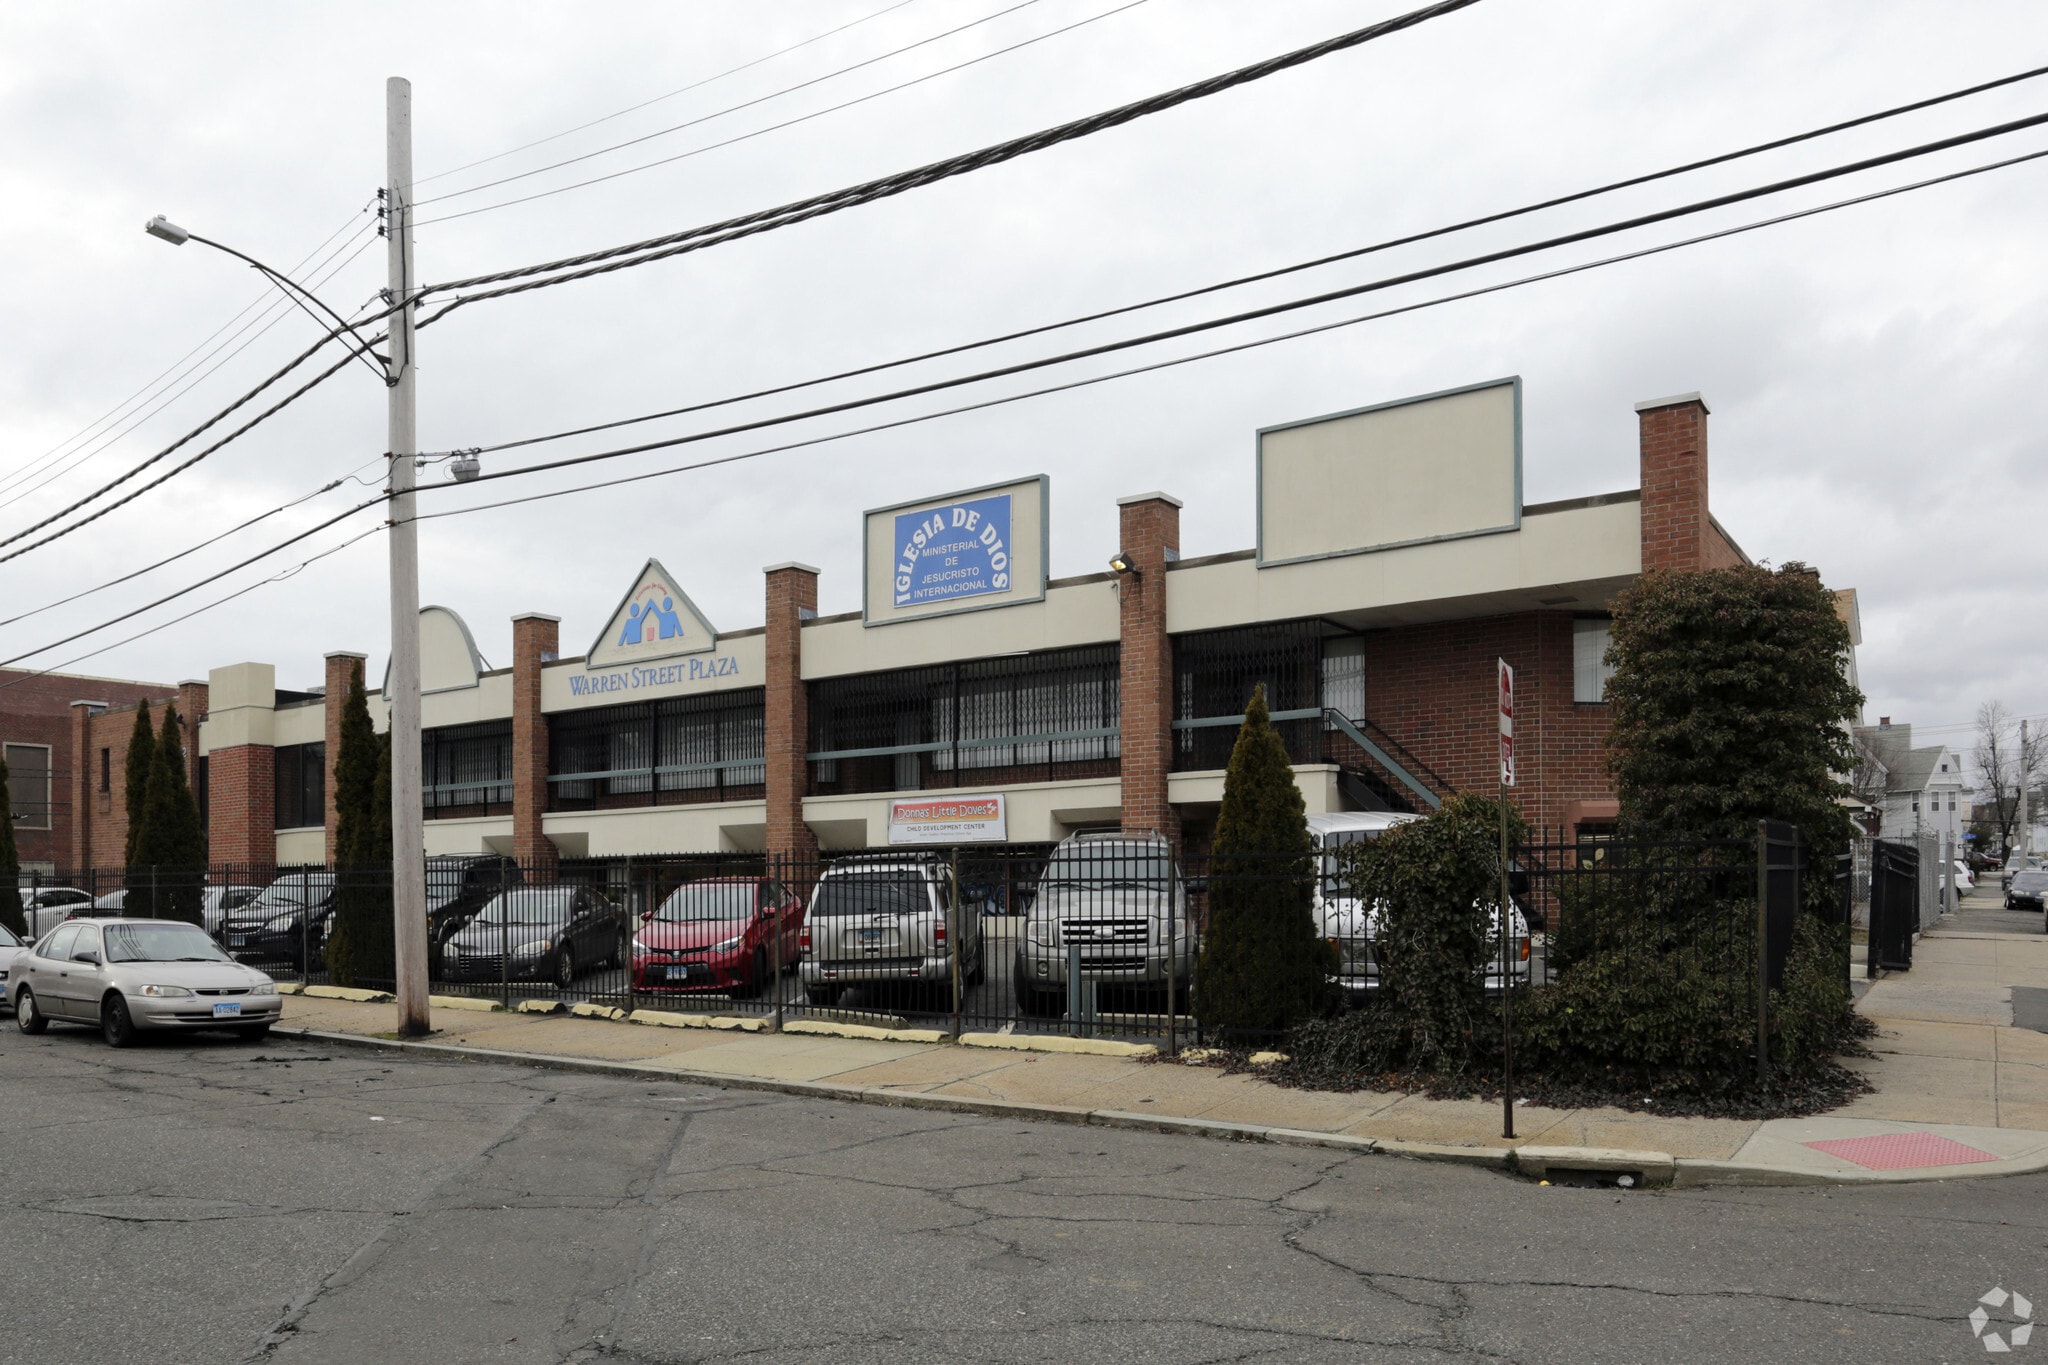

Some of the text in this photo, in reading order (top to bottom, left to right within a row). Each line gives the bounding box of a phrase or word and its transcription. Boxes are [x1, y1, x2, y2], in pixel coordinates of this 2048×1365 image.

[896, 508, 1008, 604] IGLESIA DE DIOS
[922, 540, 979, 557] MINISTERIAL
[945, 556, 958, 566] DE
[922, 567, 980, 584] JESUCRISTO
[914, 580, 987, 598] INTERNACIONAL
[568, 655, 739, 696] WARREN STREET PLAZA
[897, 804, 987, 820] Donna's Little Doves
[923, 824, 961, 832] DEVELOPMENT
